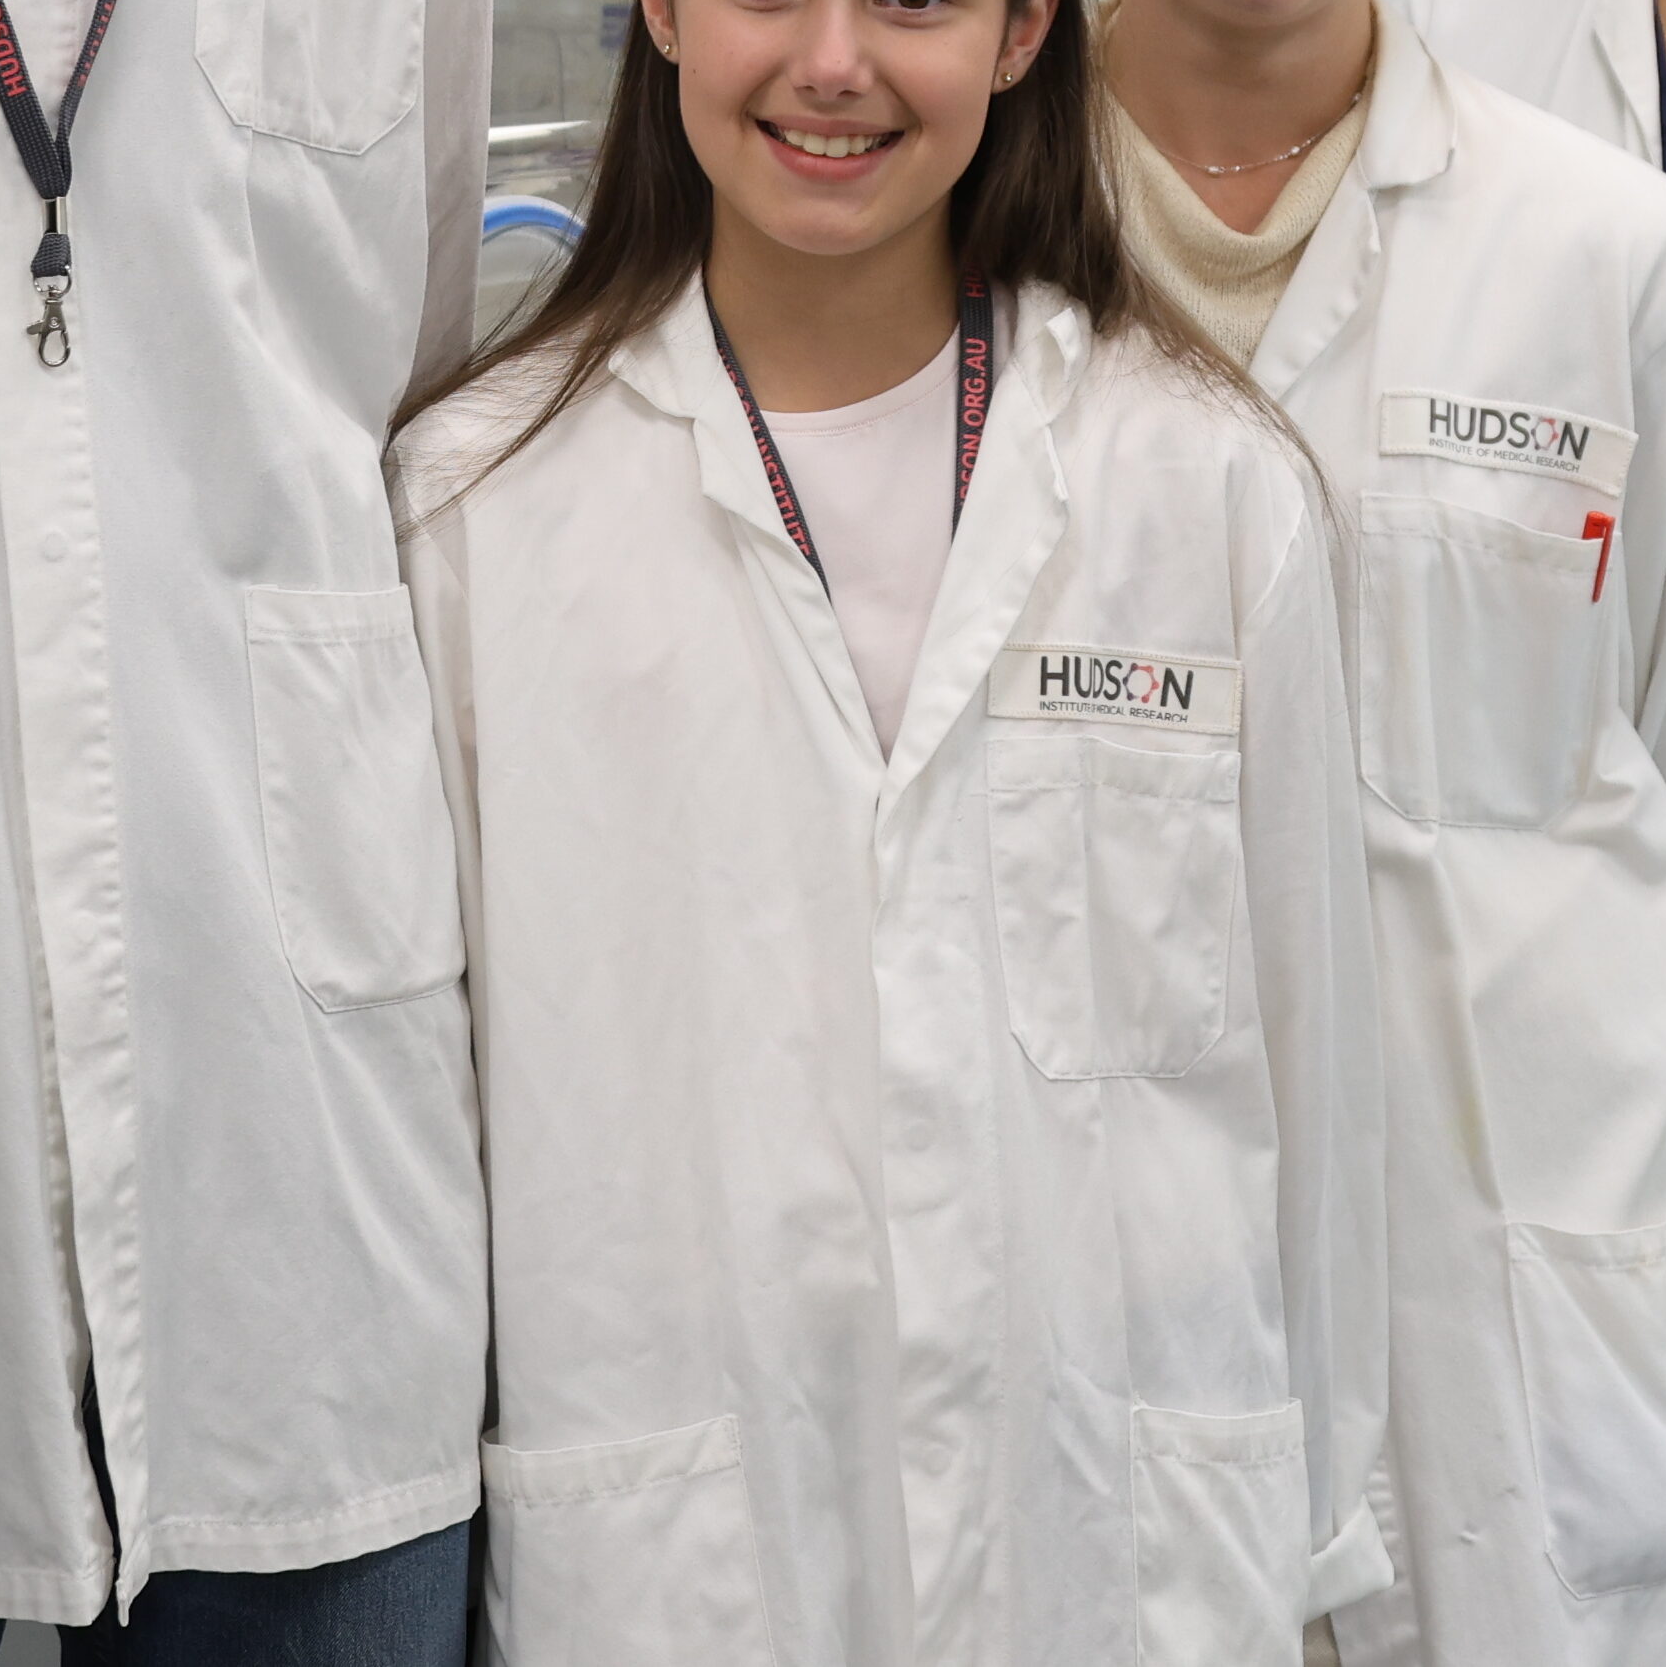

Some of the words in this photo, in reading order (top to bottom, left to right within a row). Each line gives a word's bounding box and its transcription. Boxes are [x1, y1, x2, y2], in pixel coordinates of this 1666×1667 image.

[1430, 398, 1589, 461] HUDSON
[1429, 437, 1472, 455] INSTITUTE
[1476, 448, 1490, 457] OF
[1494, 450, 1534, 464] MEDICAL
[1536, 456, 1580, 473] RESEARCH
[1039, 656, 1194, 710] HUDSON
[1039, 700, 1091, 713] INSTITUTE
[1129, 707, 1189, 723] RESEARCH
